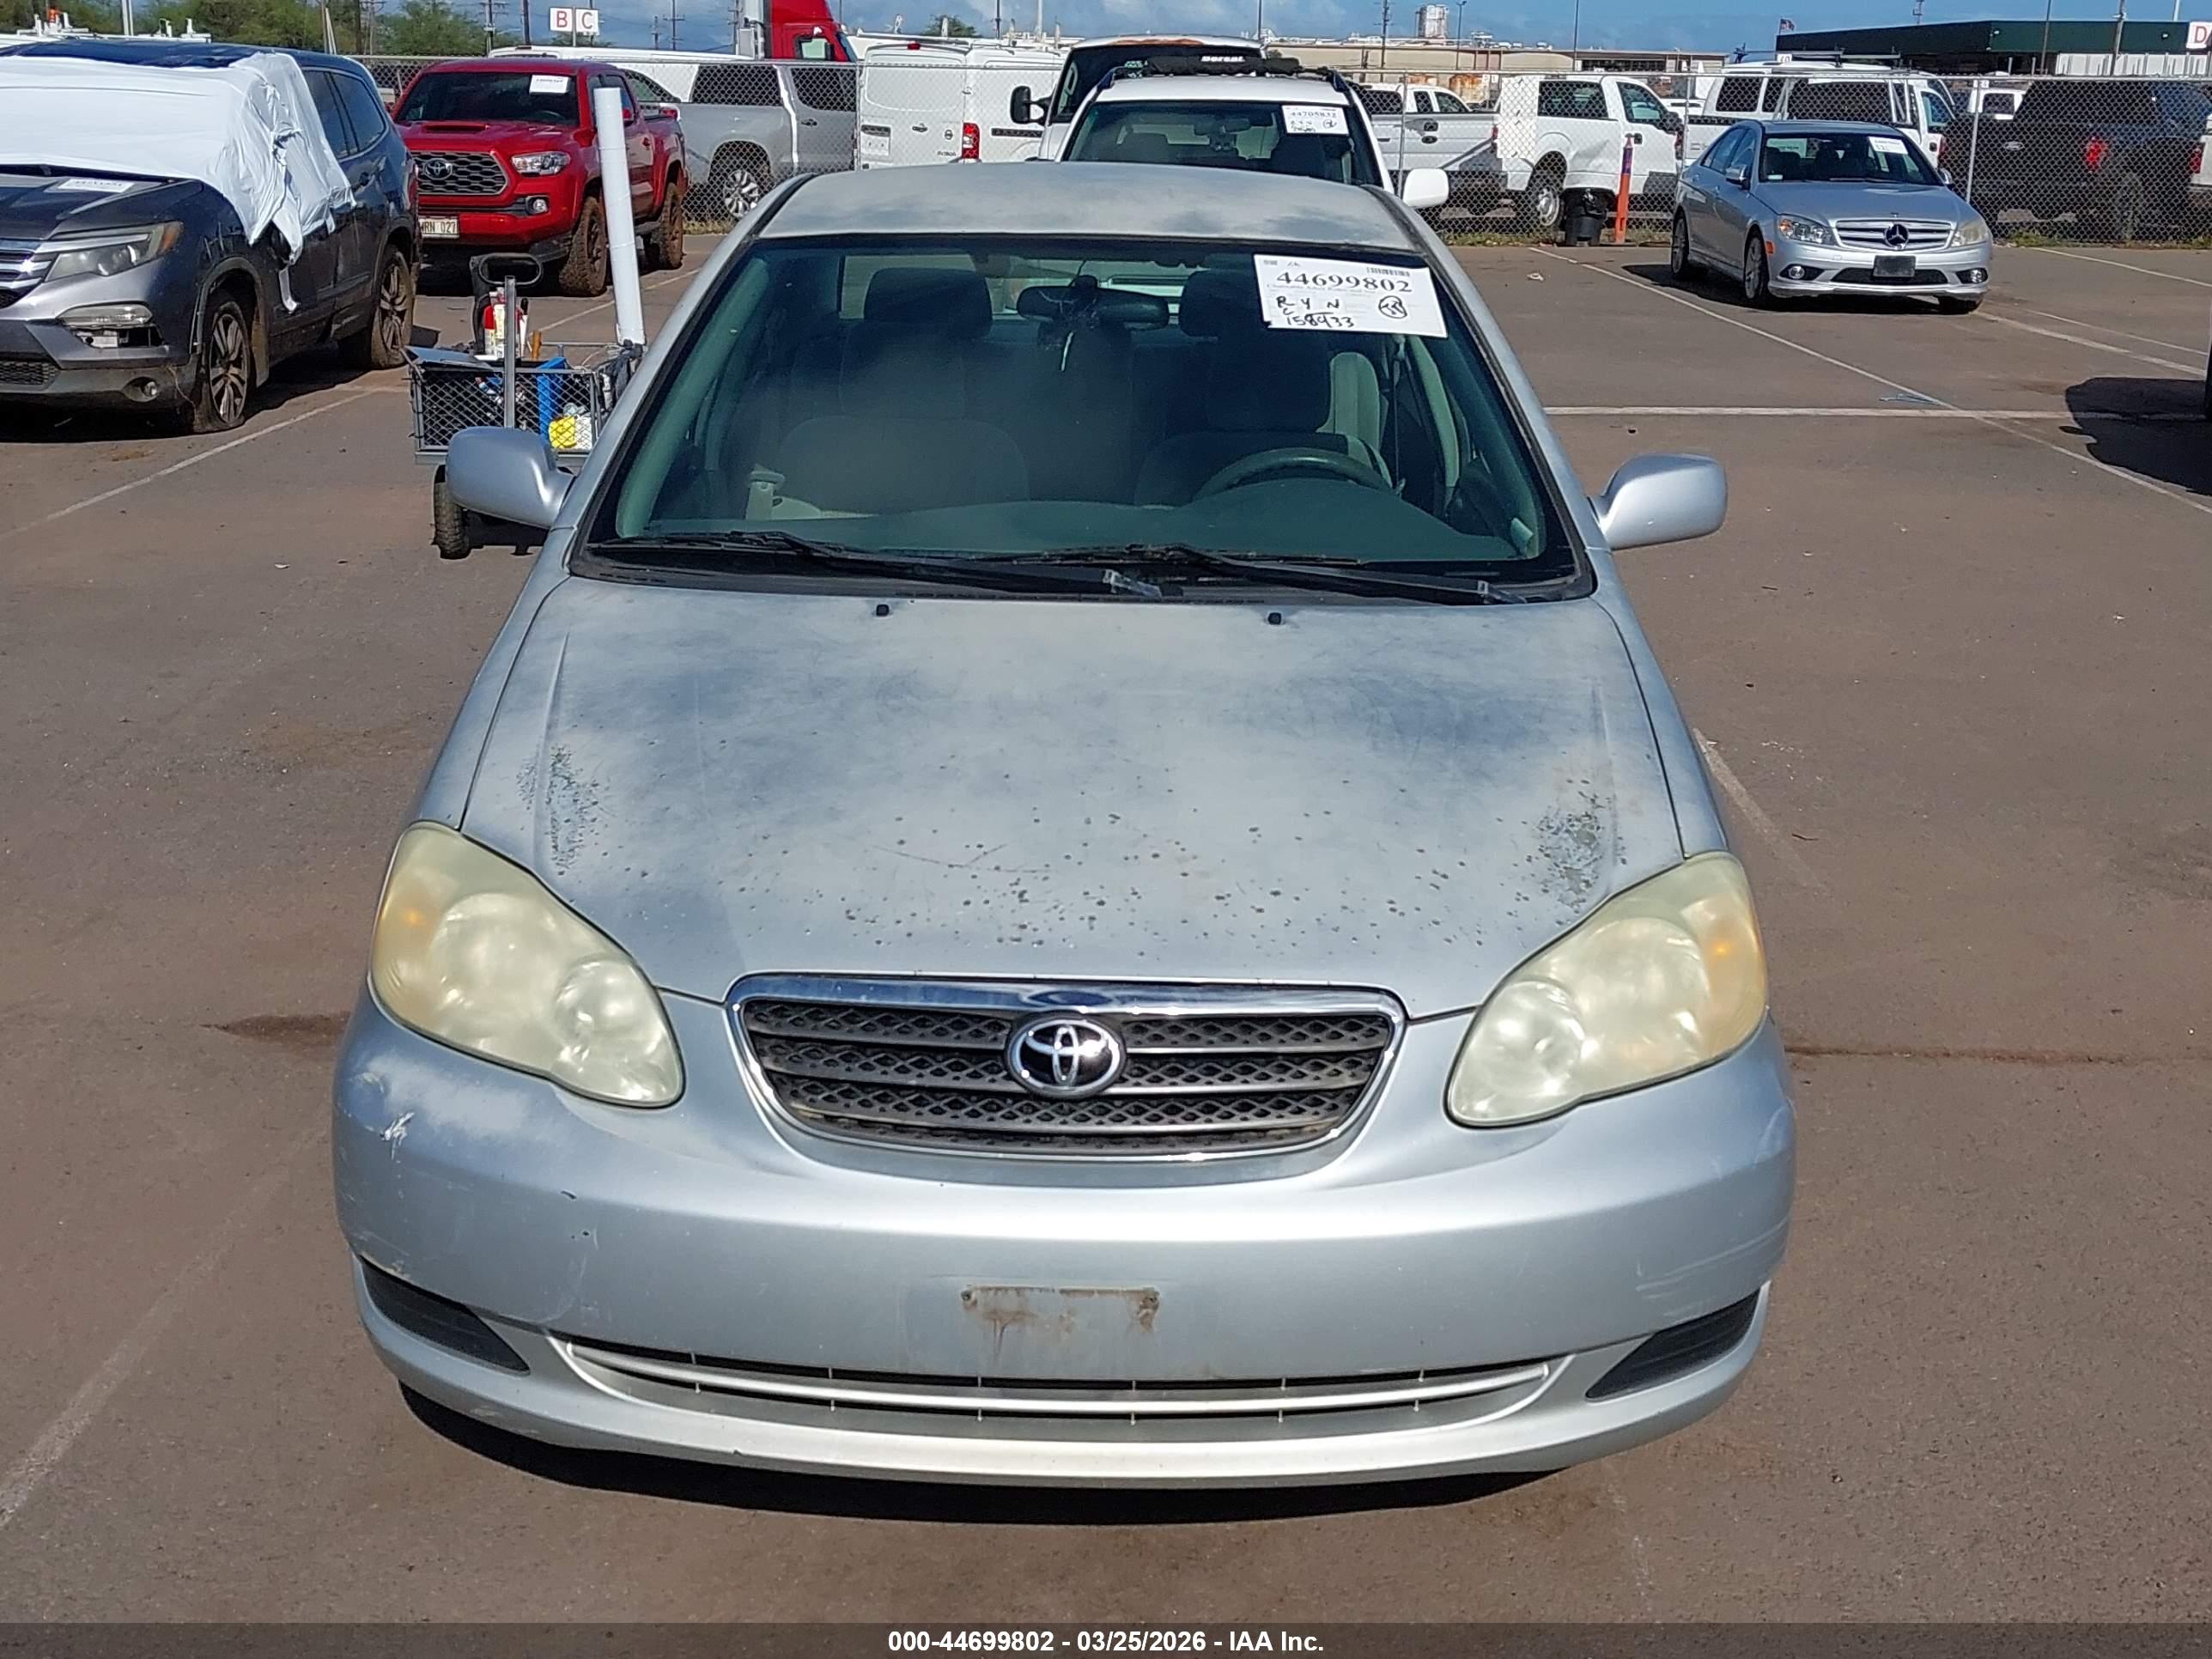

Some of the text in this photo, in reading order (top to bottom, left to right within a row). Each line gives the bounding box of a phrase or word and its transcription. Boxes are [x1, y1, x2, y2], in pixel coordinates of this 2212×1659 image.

[556, 10, 568, 28] B
[581, 11, 592, 29] C
[2194, 26, 2207, 43] D
[1276, 271, 1413, 293] 44699802
